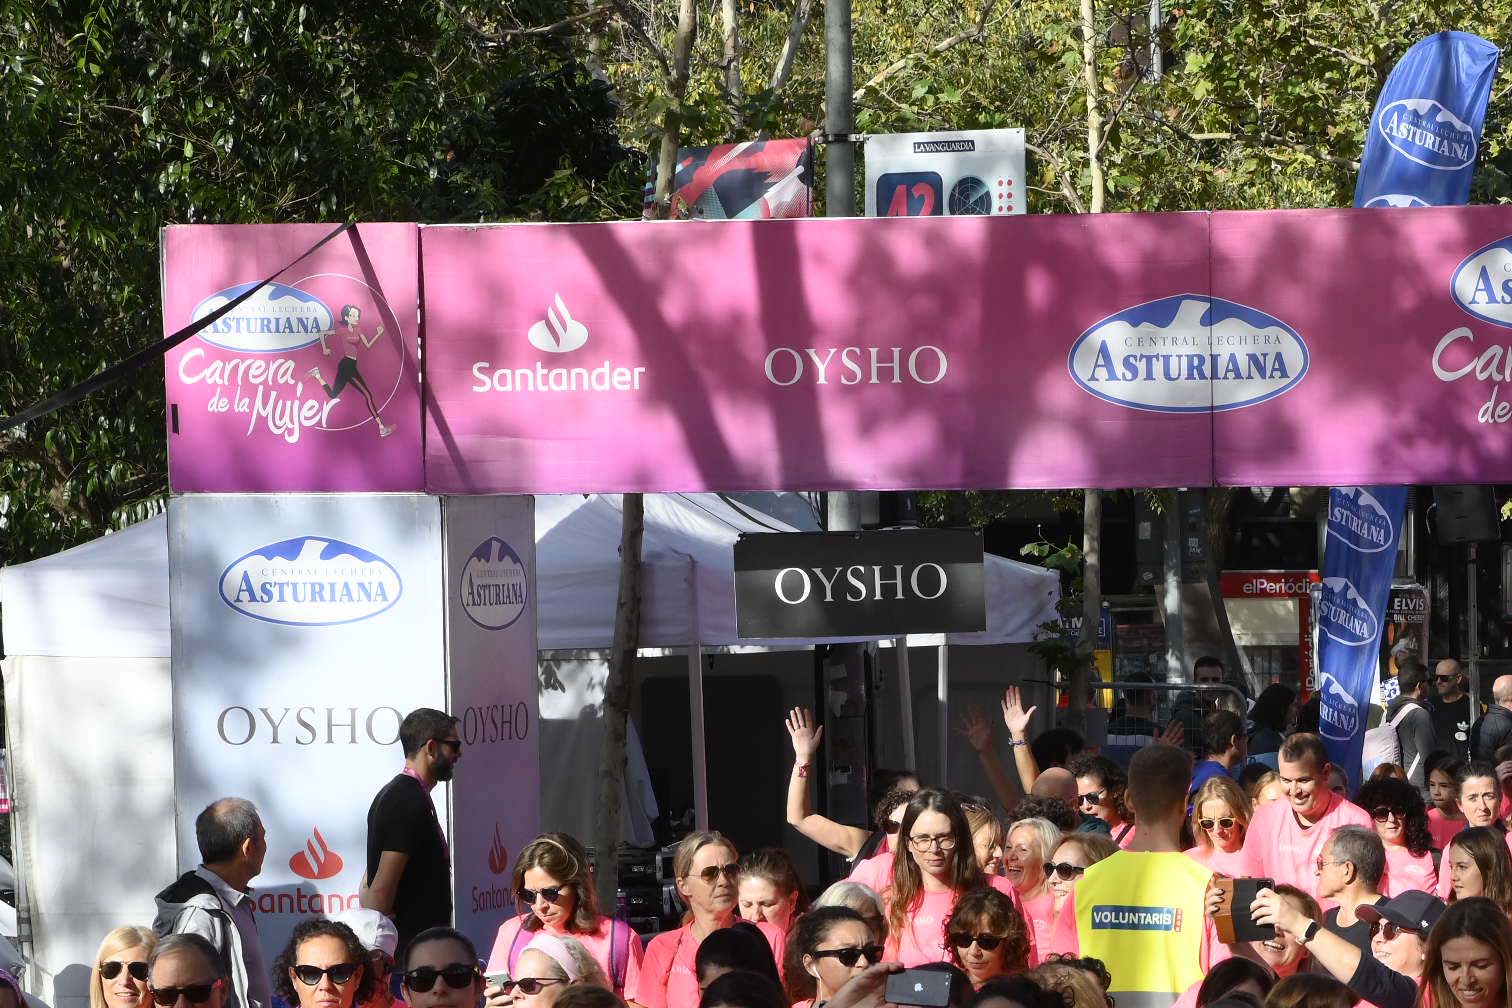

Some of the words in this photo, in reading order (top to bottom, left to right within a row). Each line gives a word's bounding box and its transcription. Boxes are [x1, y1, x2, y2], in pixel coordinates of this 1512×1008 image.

[1385, 111, 1469, 161] ASTURIANA
[1125, 336, 1199, 346] CENTRAL
[1207, 334, 1282, 346] LECHERA
[179, 347, 296, 385] Carrera
[472, 362, 645, 393] Santander
[765, 345, 948, 386] OYSHO
[1087, 338, 1290, 382] ASTURIANA
[208, 387, 229, 412] de
[234, 386, 250, 412] la
[247, 381, 341, 443] Mujer
[1478, 386, 1509, 424] de
[1328, 507, 1385, 545] STURIANA
[235, 569, 389, 603] ASTURIANA
[466, 572, 524, 607] ASTURIANA
[774, 562, 949, 605] OYSHO
[1319, 601, 1369, 639] STURIANA
[1394, 598, 1424, 610] ELVIS
[217, 705, 402, 746] OYSHO
[463, 701, 529, 746] OYSHO
[1093, 911, 1172, 925] VOLUNTARIS
